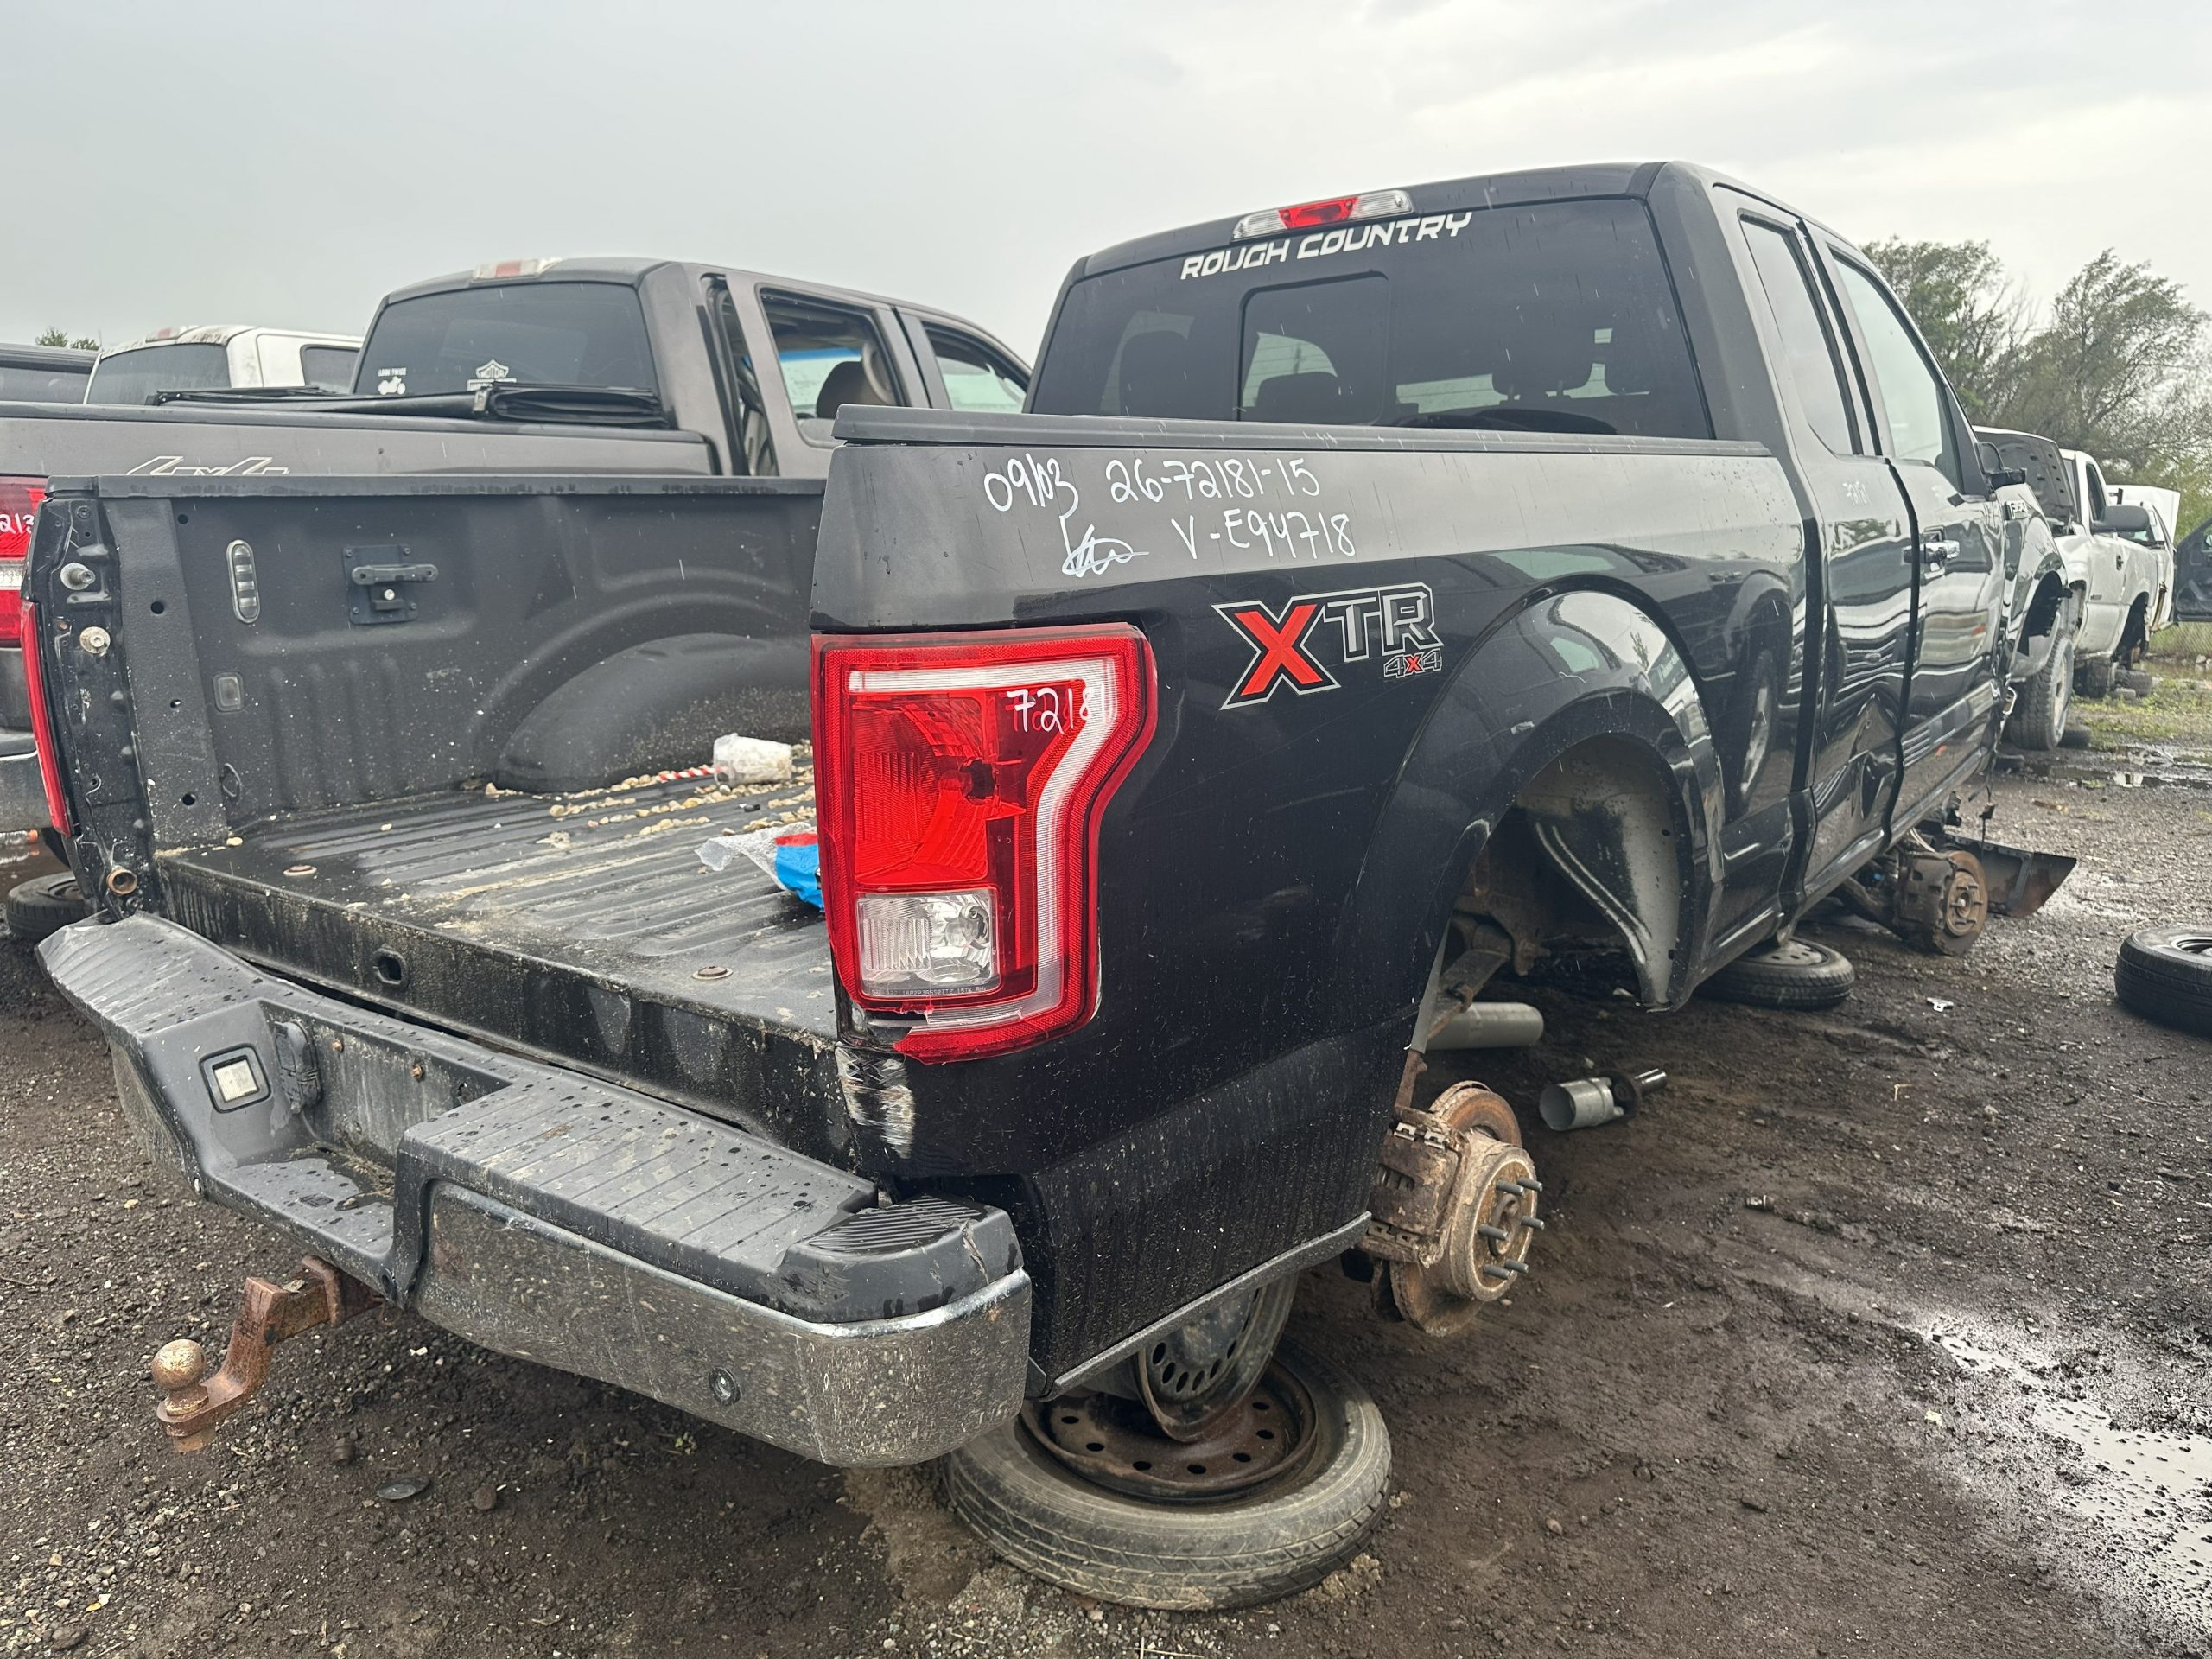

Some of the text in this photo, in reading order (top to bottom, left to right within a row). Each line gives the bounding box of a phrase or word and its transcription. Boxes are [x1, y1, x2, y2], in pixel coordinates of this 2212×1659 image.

[1180, 212, 1472, 280] ROUGH COUNTRY
[1105, 458, 1320, 503] 26-72181-15
[1211, 582, 1444, 710] XTR
